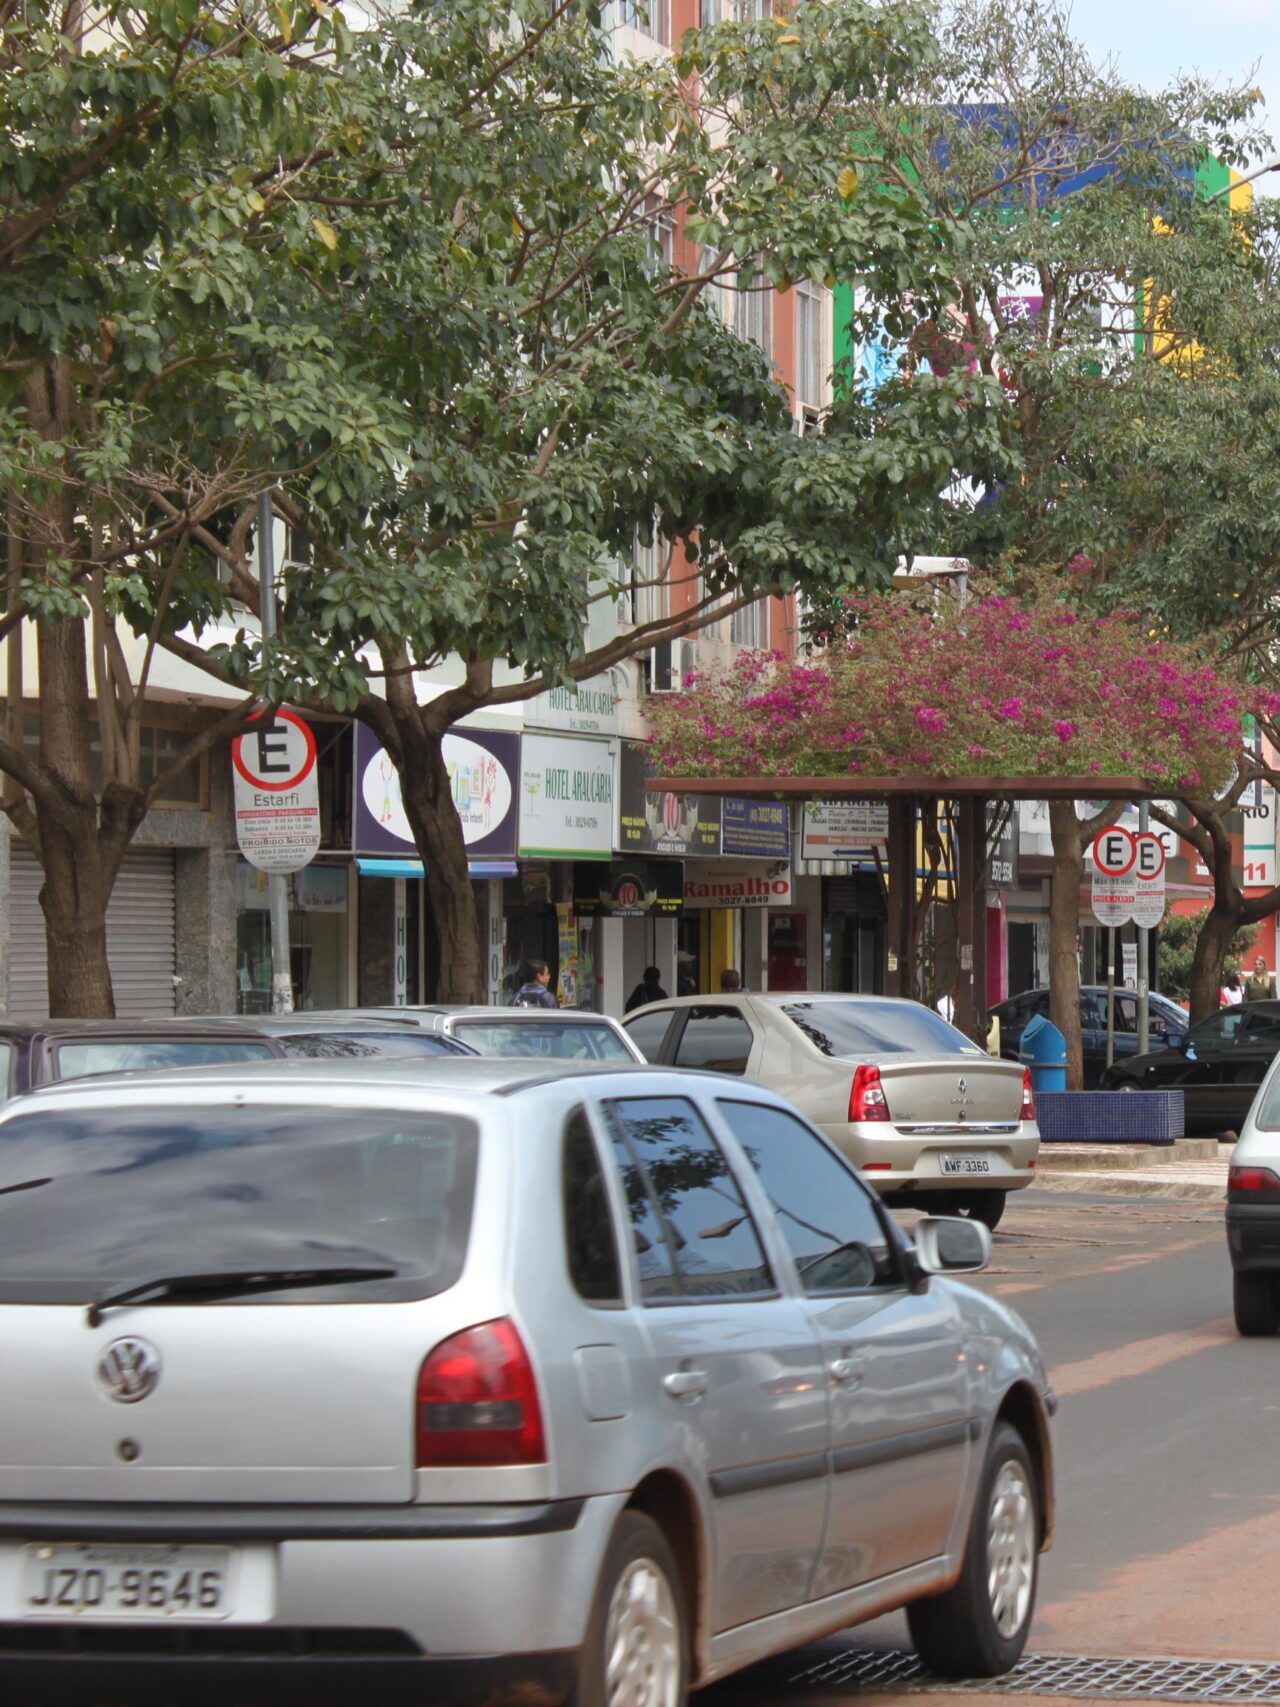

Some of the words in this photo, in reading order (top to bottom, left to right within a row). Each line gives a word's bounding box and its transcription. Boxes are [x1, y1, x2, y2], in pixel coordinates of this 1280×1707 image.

[549, 687, 573, 711] HOTEL
[257, 726, 290, 771] E
[545, 768, 570, 801] HOTEL
[254, 793, 299, 807] Estarfi
[242, 838, 284, 847] PROIBIDO
[286, 837, 317, 845] MOTOS
[1106, 836, 1123, 865] E
[1140, 843, 1154, 870] E
[684, 878, 789, 898] Ramalho
